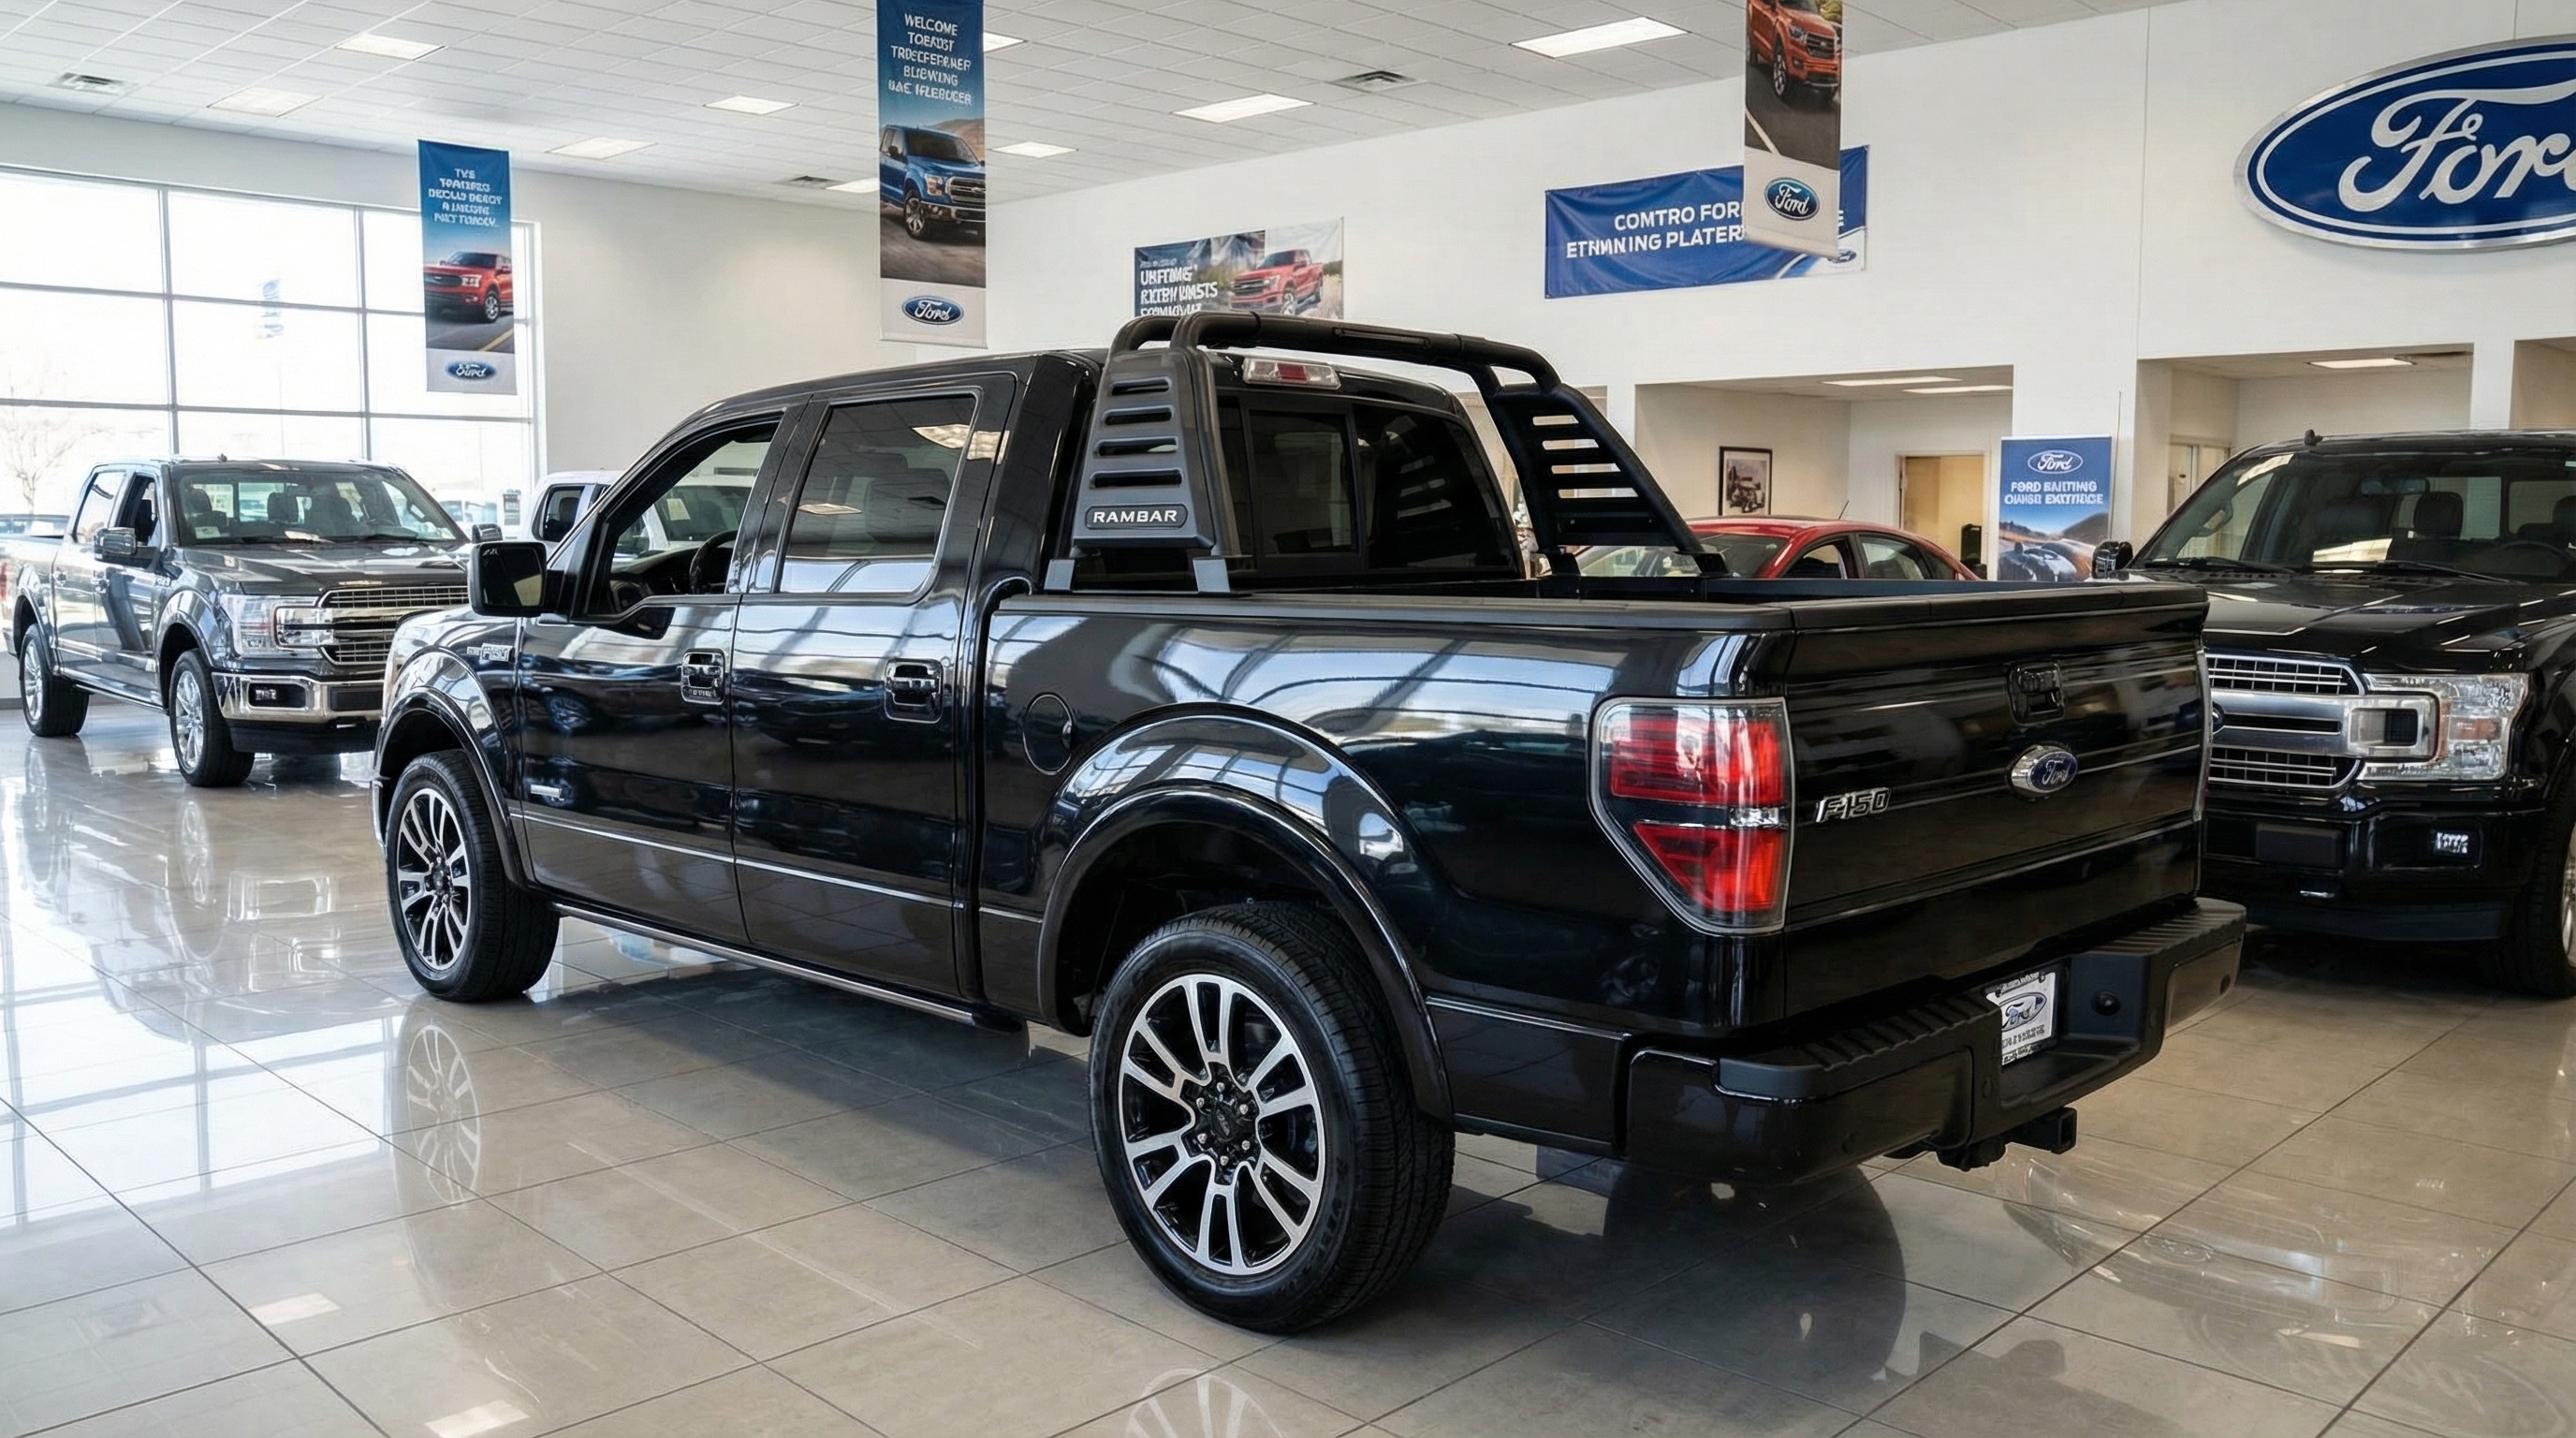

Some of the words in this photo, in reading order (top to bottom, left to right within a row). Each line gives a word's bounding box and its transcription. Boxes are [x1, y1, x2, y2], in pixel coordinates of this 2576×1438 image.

[904, 13, 958, 36] WELCOME
[2338, 79, 2576, 212] For
[1775, 183, 1809, 216] Ford
[1614, 206, 1695, 231] COMTRO
[1700, 201, 1743, 222] FOR
[915, 300, 951, 322] Ford
[2037, 453, 2073, 470] Ford
[2011, 481, 2042, 492] FORD
[1092, 510, 1178, 523] RAMBAR
[2042, 759, 2071, 785] Ford
